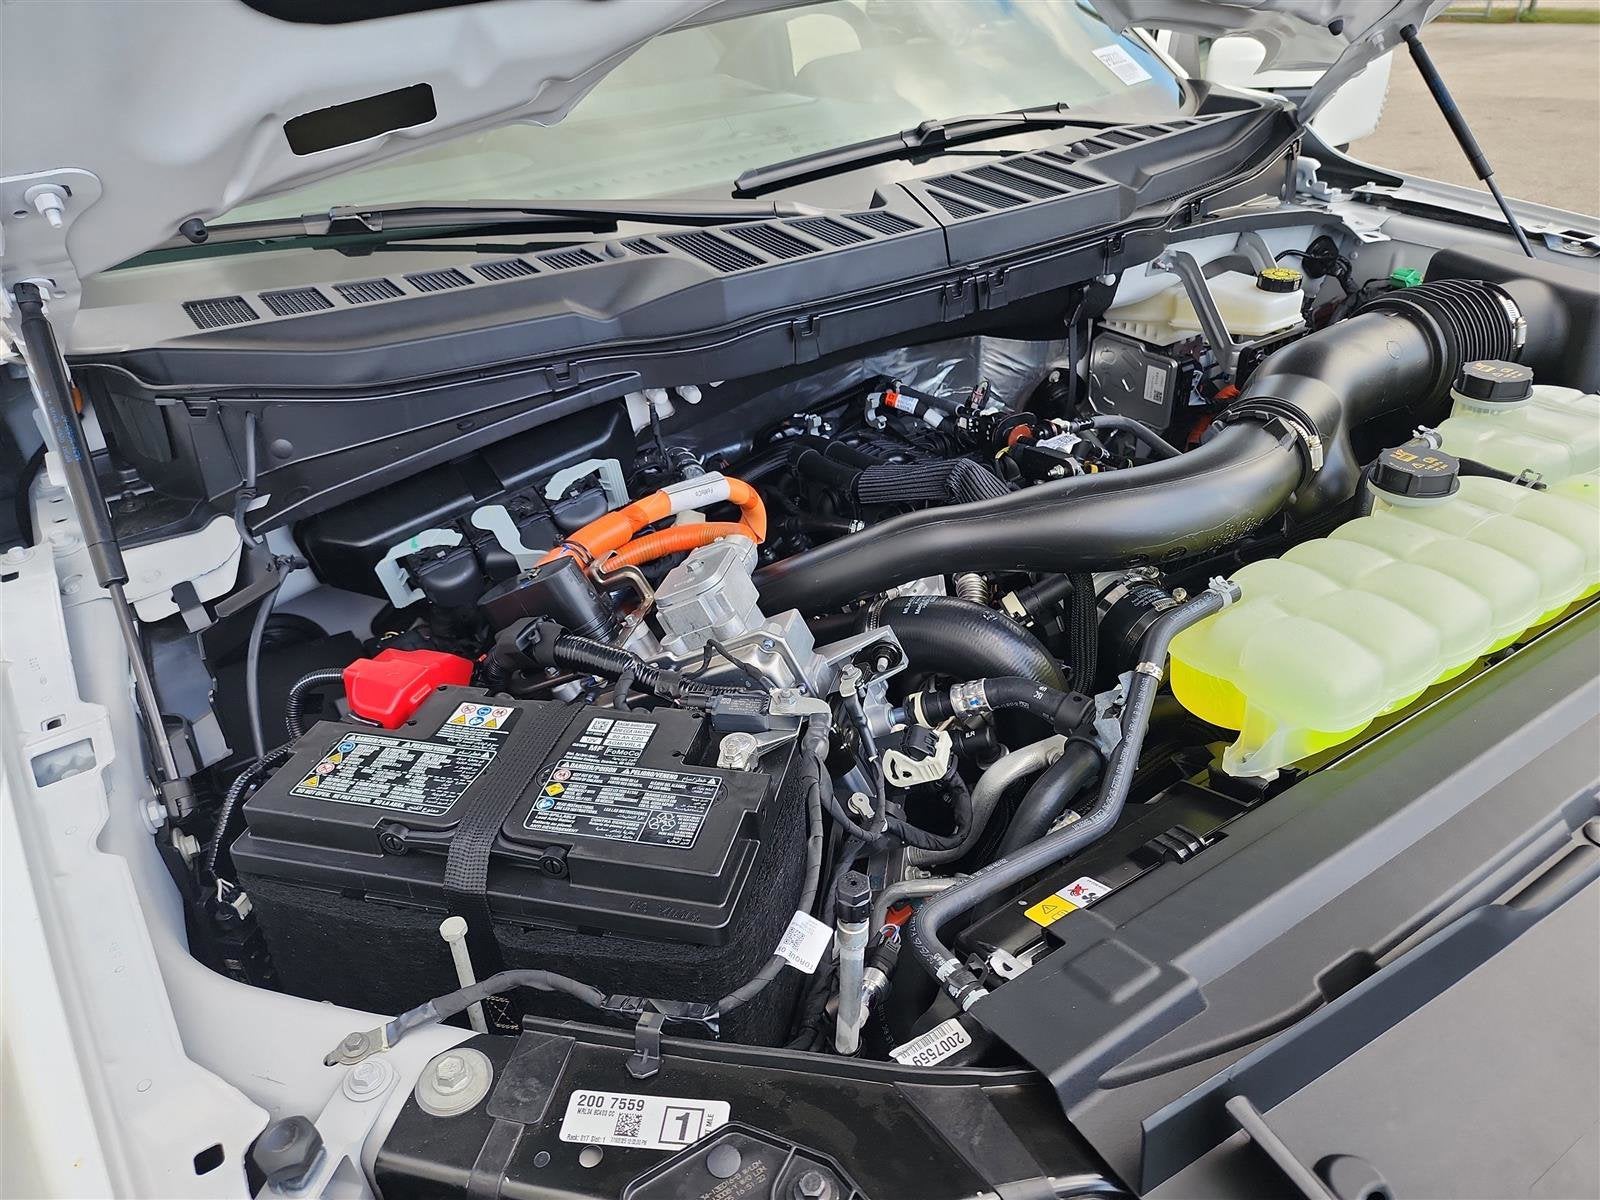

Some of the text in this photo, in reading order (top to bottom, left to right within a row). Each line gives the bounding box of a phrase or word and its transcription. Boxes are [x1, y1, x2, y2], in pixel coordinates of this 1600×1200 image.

[606, 748, 641, 757] FoMoCo
[789, 951, 815, 971] TORQUE
[911, 1031, 965, 1067] 2007559
[577, 1094, 645, 1111] 200 7559
[675, 1112, 691, 1141] 1
